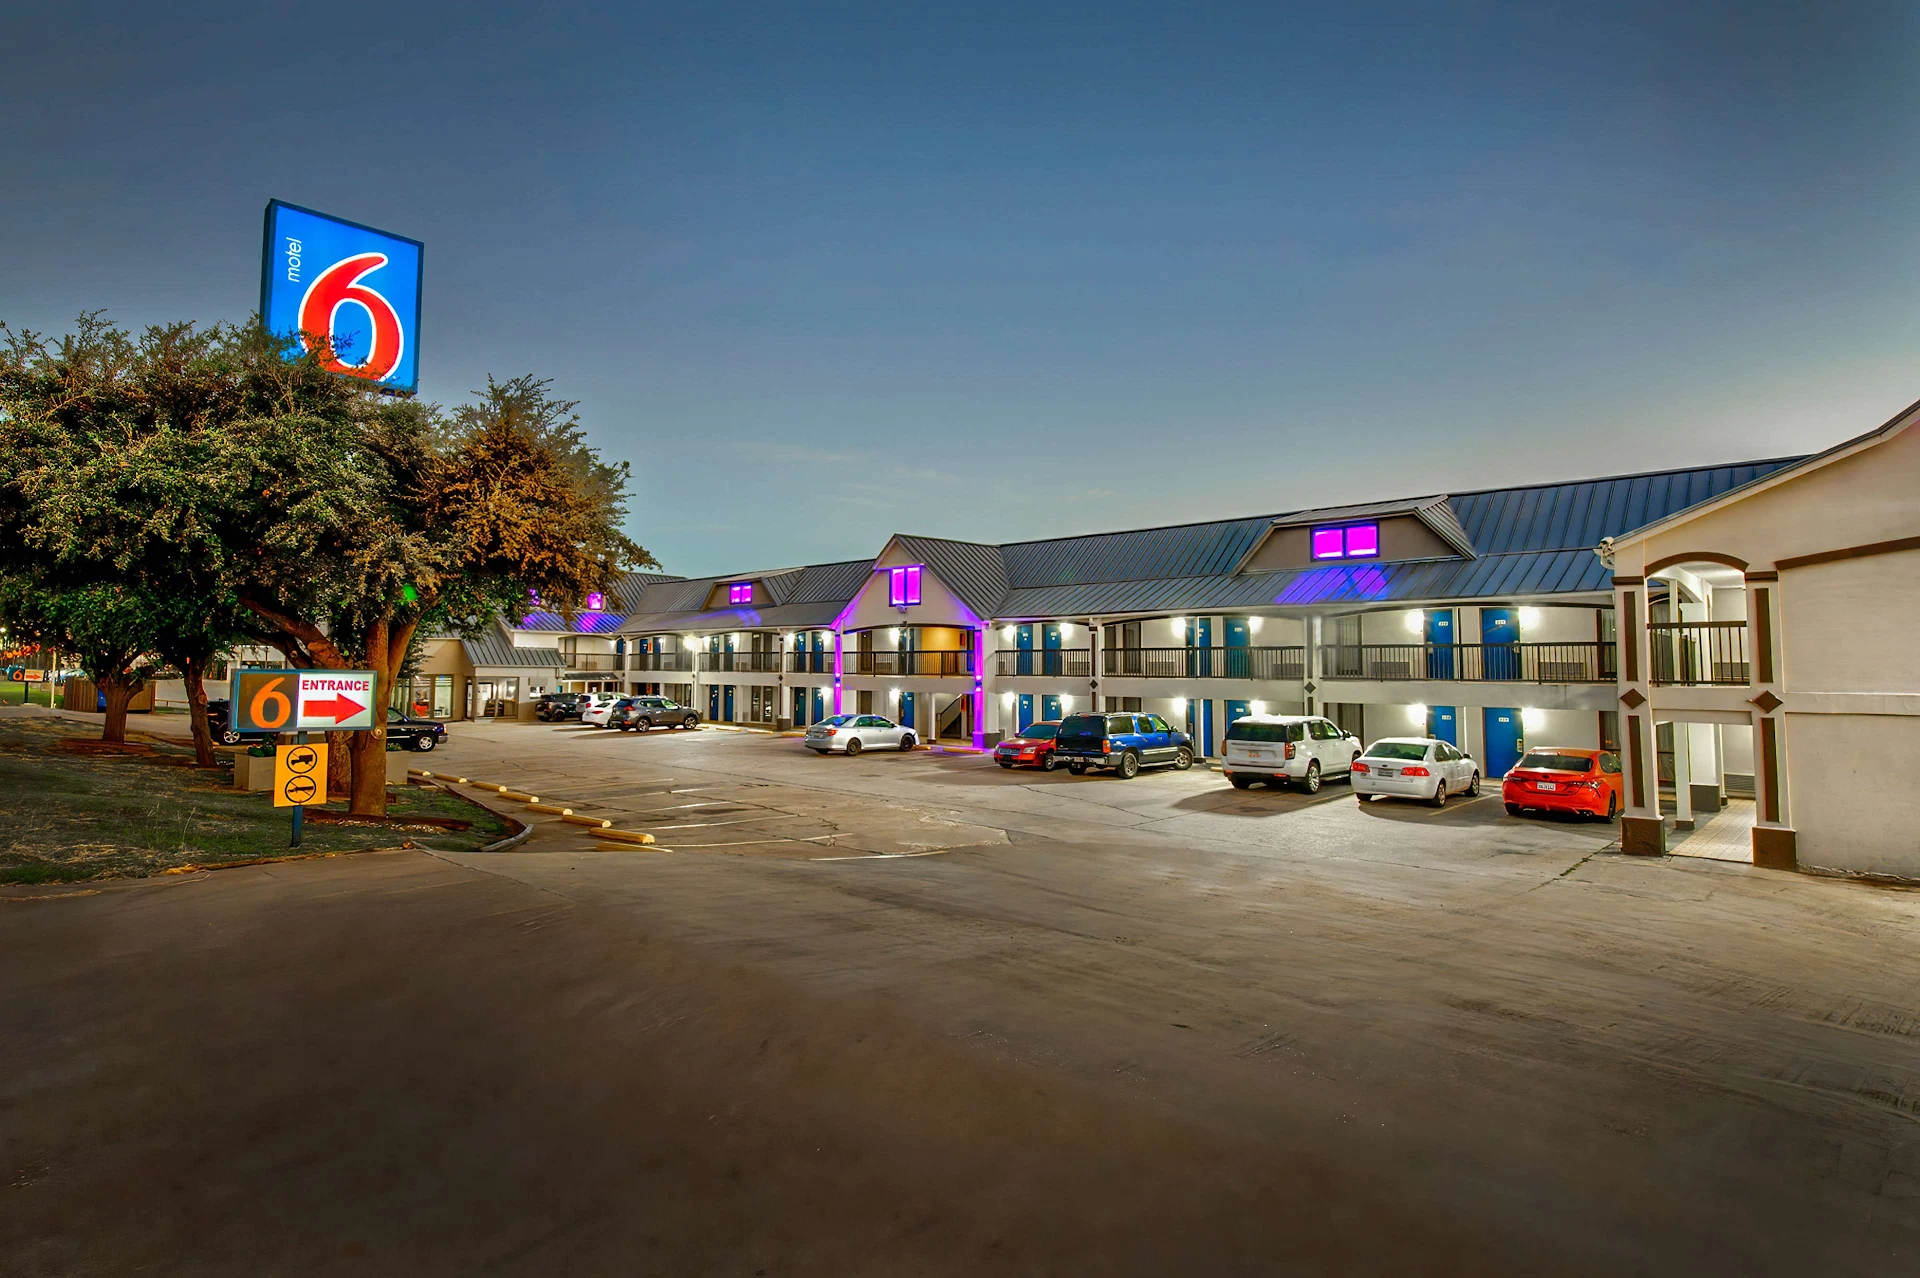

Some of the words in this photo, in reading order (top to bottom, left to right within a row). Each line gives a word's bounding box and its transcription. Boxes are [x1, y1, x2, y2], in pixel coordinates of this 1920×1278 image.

[286, 237, 302, 283] motel
[298, 252, 404, 382] 6
[13, 669, 23, 681] 6
[302, 680, 370, 691] ENTRANCE
[250, 677, 292, 729] 6
